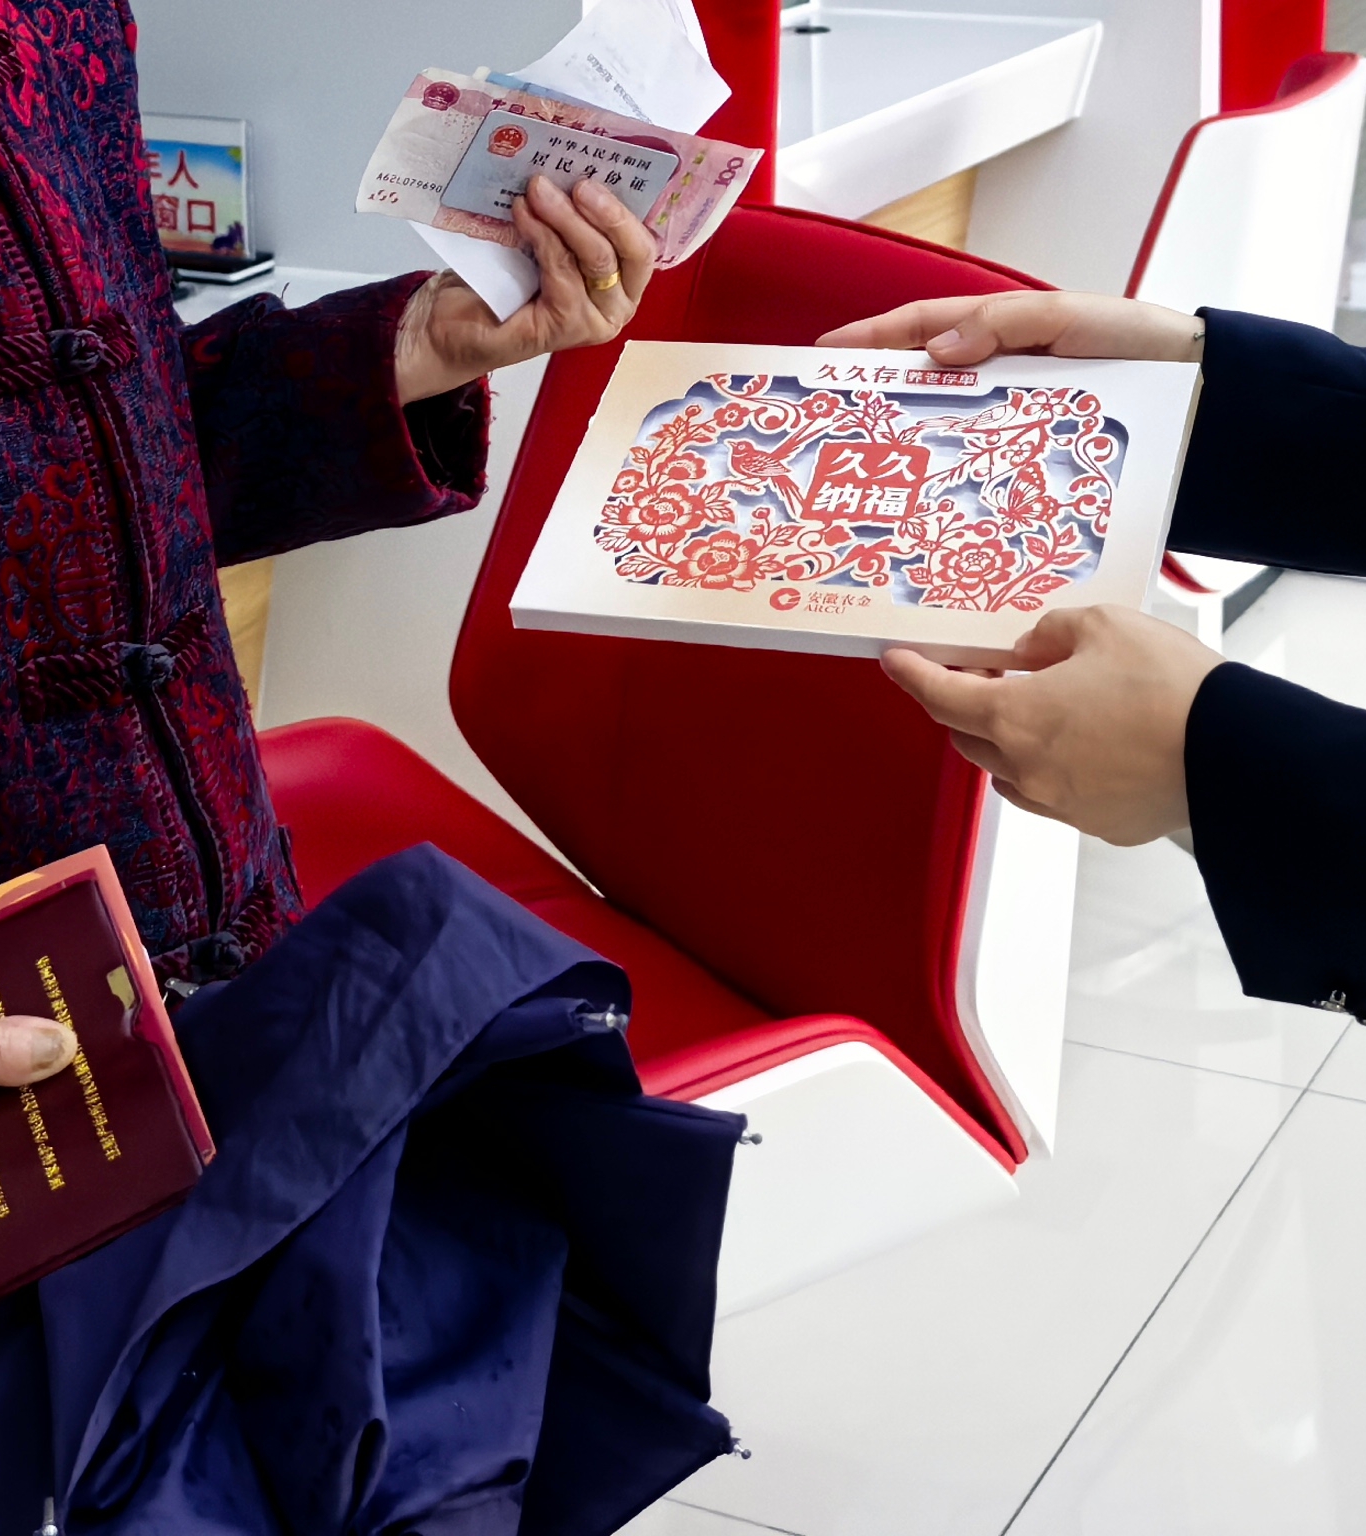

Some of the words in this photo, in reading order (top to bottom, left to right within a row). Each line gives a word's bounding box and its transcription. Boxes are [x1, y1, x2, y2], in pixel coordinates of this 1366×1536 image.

[549, 137, 652, 170] 中华人民共和国
[530, 151, 650, 192] 居民身份证
[714, 157, 744, 188] 100
[152, 194, 215, 233] 窗口
[814, 364, 900, 384] 久久存
[824, 448, 917, 482] 久久
[811, 480, 913, 517] 纳福
[803, 604, 846, 614] ARCU
[807, 591, 871, 607] 安徽农金
